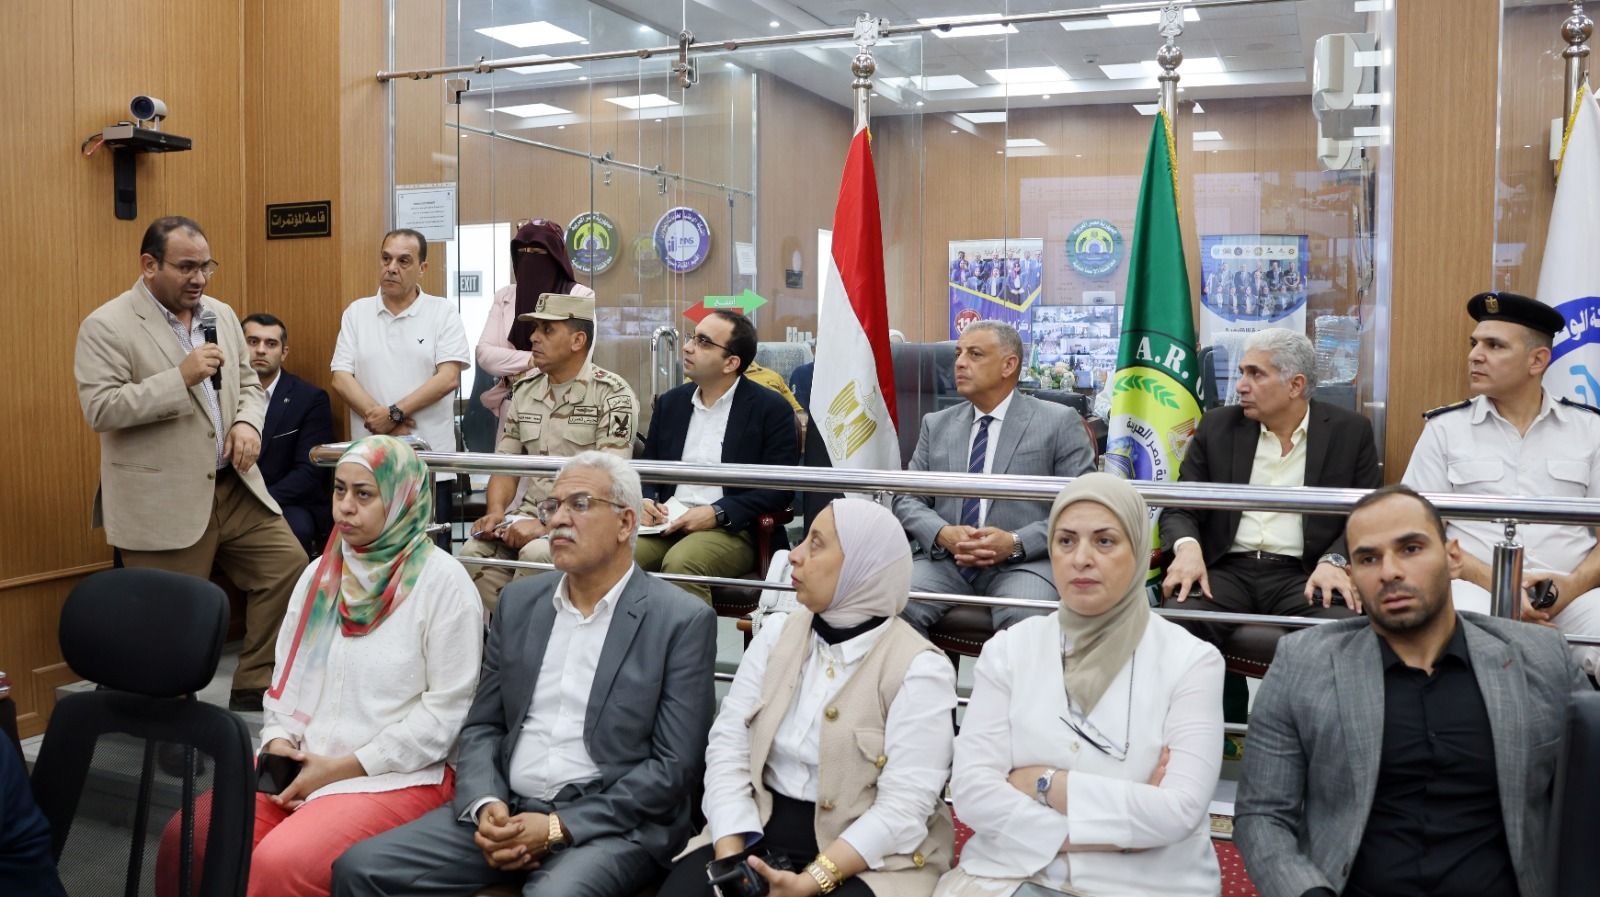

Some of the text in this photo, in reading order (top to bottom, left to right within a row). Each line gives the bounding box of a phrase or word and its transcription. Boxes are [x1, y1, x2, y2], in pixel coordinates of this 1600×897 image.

[271, 210, 326, 229] قاعة المؤتمرات
[460, 276, 477, 290] EXIT
[1126, 417, 1153, 440] العربية
[1146, 441, 1162, 466] مصر
